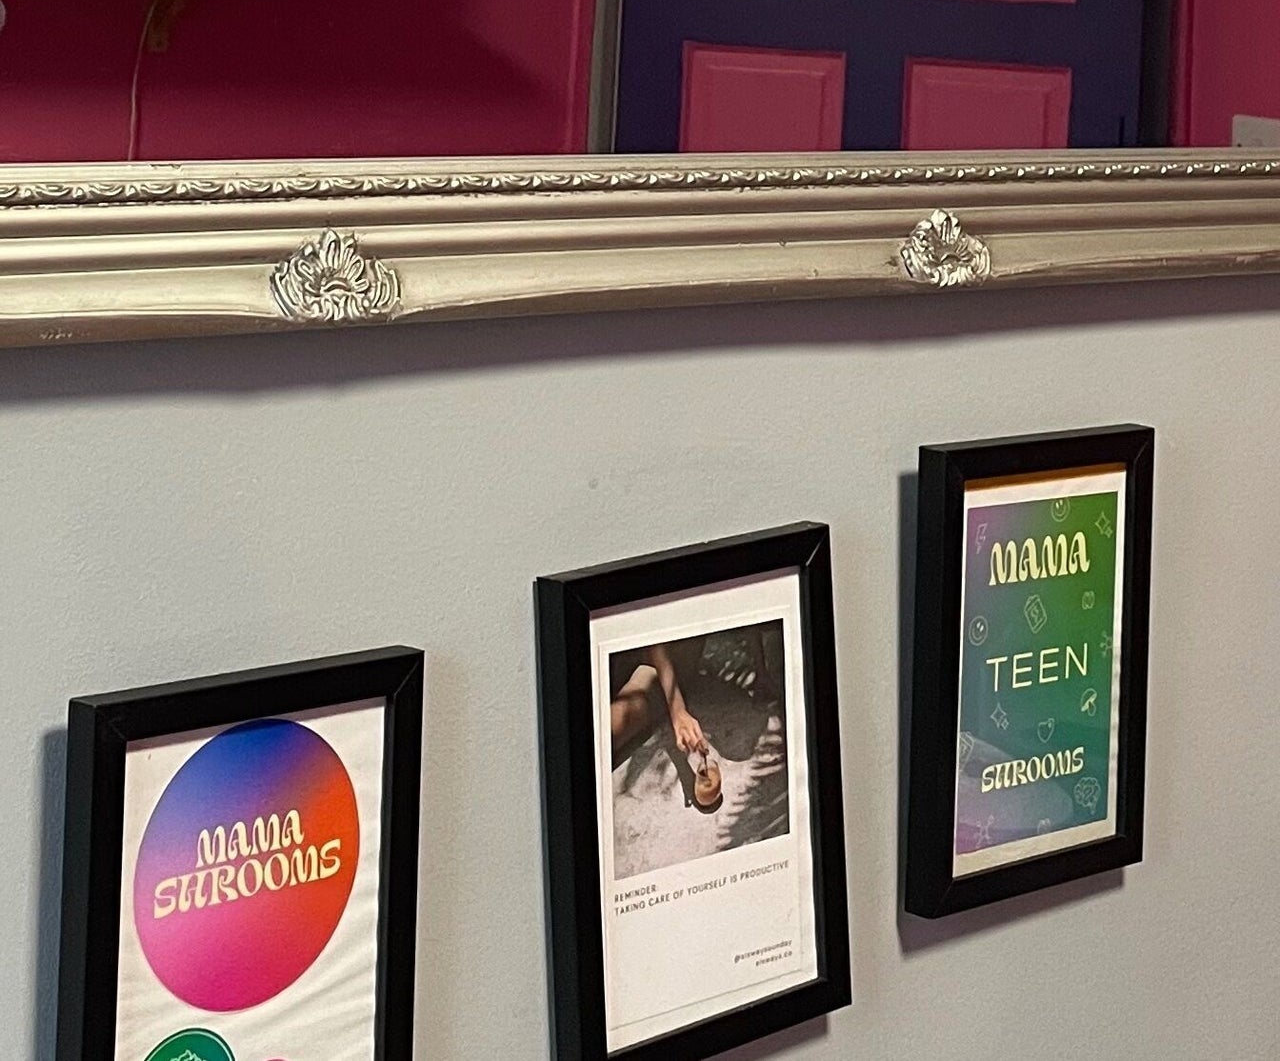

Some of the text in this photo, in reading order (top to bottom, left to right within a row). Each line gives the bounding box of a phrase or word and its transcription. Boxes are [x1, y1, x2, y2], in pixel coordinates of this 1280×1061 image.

[988, 530, 1091, 587] MAMA
[985, 642, 1088, 693] TEEN
[981, 746, 1085, 794] SHROOMS
[195, 809, 305, 869] MAMA
[153, 838, 342, 919] SHROOMS
[615, 859, 790, 916] TAKING CARE OF YOURSELF IS PRODUCTIVE
